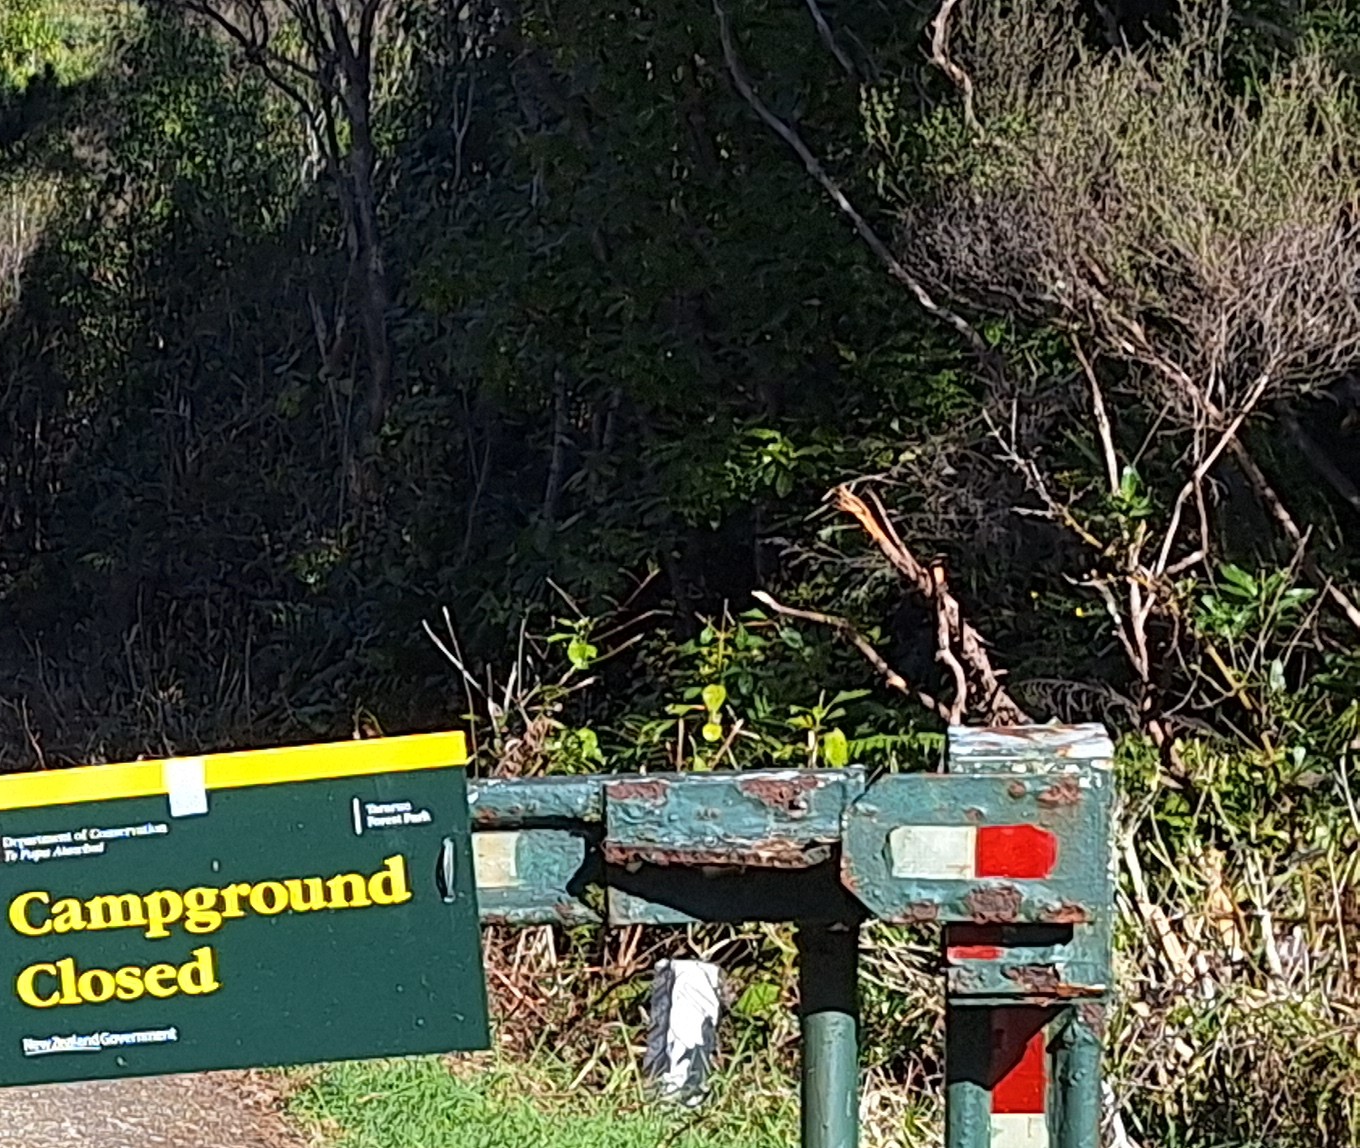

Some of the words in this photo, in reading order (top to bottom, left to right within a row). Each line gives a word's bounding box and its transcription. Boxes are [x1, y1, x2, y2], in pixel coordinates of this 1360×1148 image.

[2, 832, 72, 850] Department
[74, 829, 88, 841] of
[8, 855, 412, 939] Campground
[16, 946, 220, 1008] Closed
[22, 1038, 51, 1051] New
[51, 1033, 100, 1048] Zealand
[100, 1027, 178, 1046] Government
